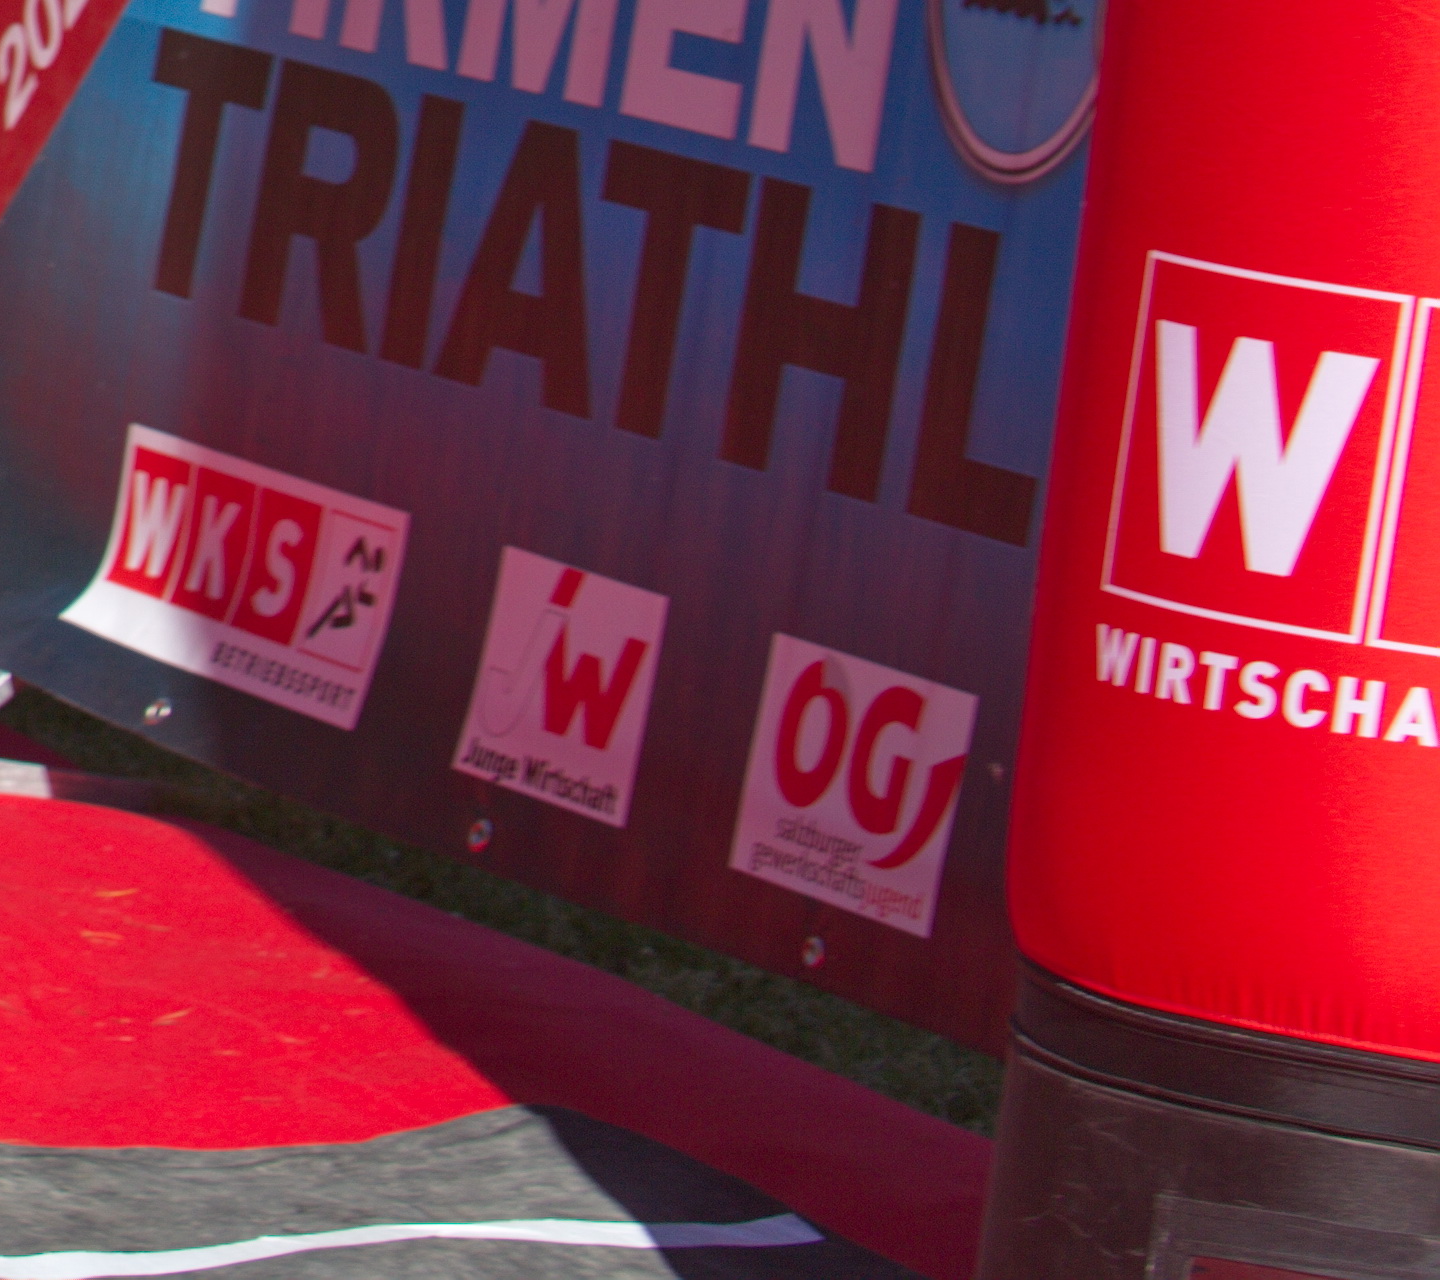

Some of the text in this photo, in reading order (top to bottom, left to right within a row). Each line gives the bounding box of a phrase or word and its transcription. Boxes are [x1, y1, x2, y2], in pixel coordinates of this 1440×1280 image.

[152, 26, 1037, 548] TRIATHL
[124, 468, 305, 618] WKS
[1095, 622, 1440, 747] WIRTSCHA
